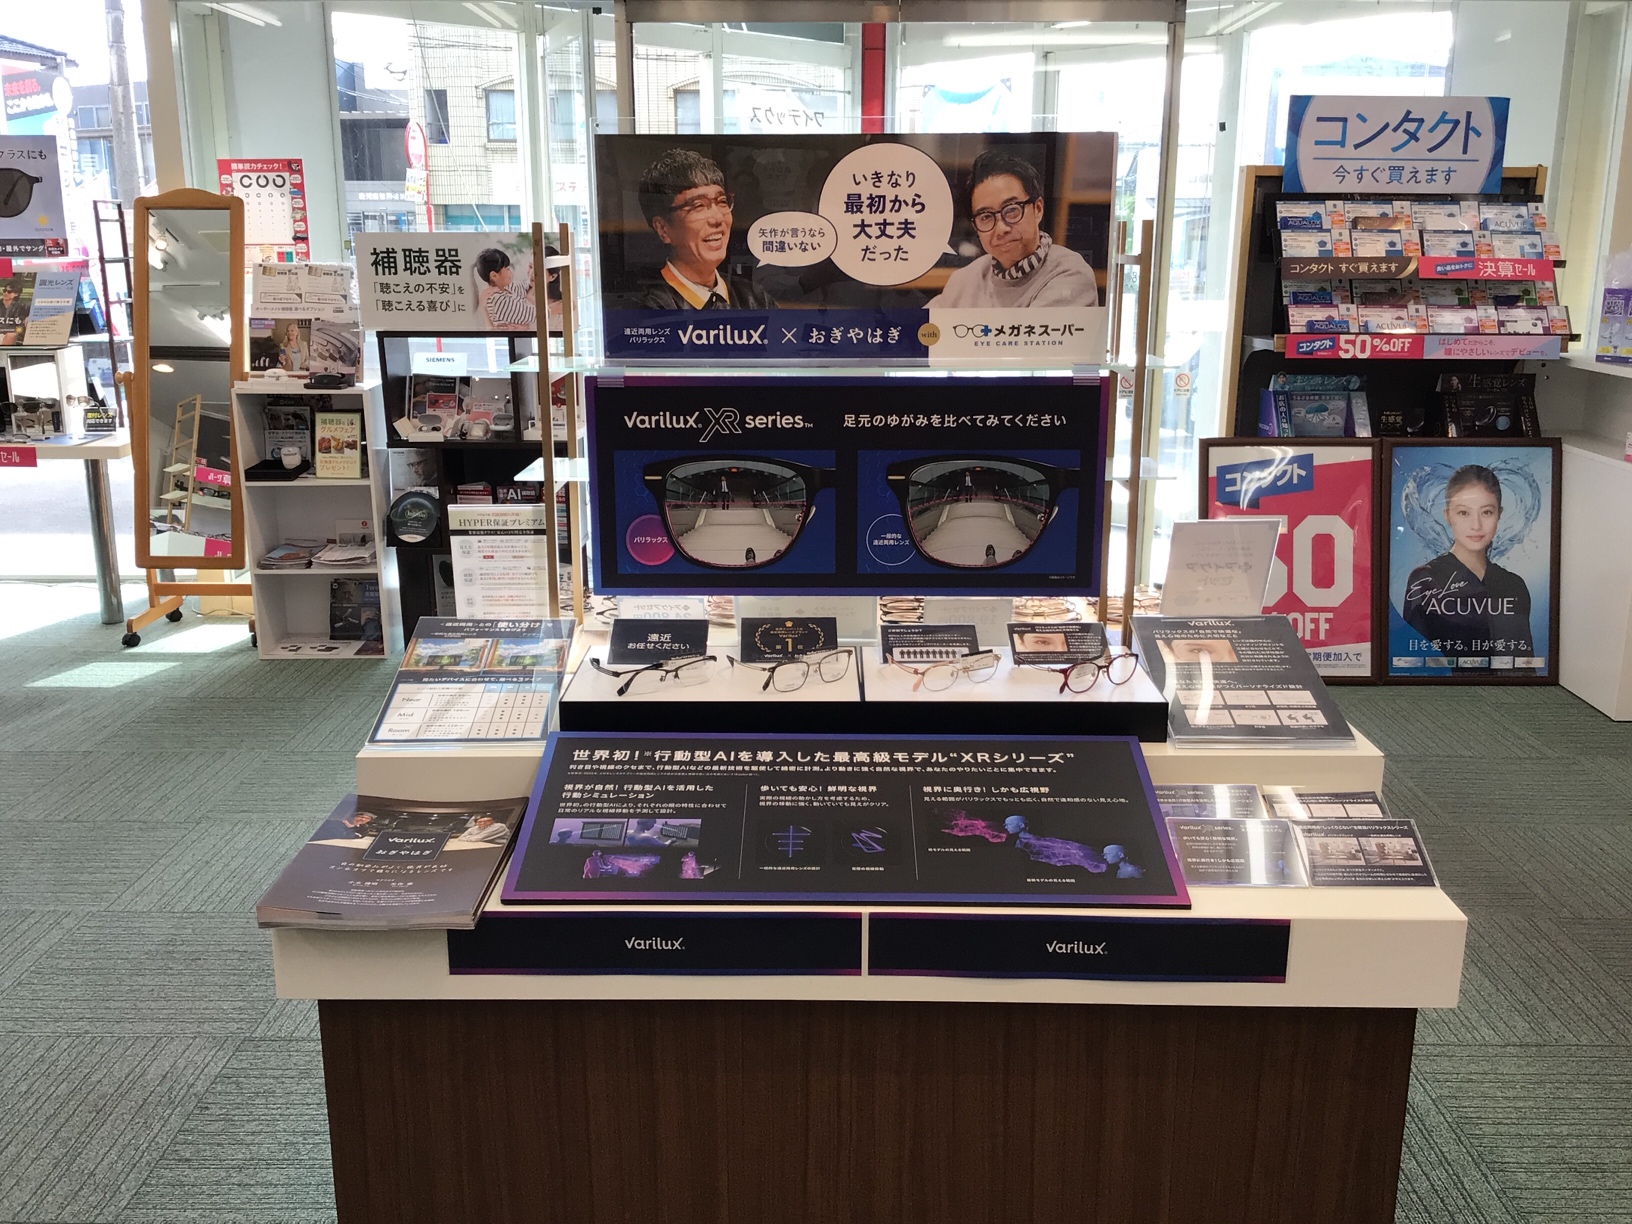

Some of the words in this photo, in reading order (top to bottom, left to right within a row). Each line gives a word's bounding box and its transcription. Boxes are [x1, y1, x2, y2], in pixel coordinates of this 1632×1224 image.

[1312, 108, 1482, 155] コンタクト
[851, 170, 918, 188] いきなり
[1332, 164, 1457, 186] 今すぐ買えます
[843, 193, 926, 214] 最初から
[757, 227, 826, 240] 矢作が言うなら
[851, 219, 918, 240] 大丈夫
[761, 239, 822, 254] 間違いない
[860, 245, 910, 262] だった
[370, 247, 463, 277] 補聴器
[1290, 263, 1334, 274] コンタクト
[1339, 262, 1399, 273] すぐ買えます
[1478, 260, 1536, 278] 決算セール
[373, 282, 466, 295] 「聴こえの不安」を
[375, 300, 466, 313] 「聴こえる喜び」に
[623, 327, 671, 336] 遠近両用レンズ
[808, 326, 902, 345] おぎやはぎ
[921, 331, 938, 340] with
[993, 323, 1085, 338] メガネスーパー
[629, 336, 666, 345] バリラックス
[1298, 340, 1333, 352] コンタクト
[623, 410, 699, 429] Varilux
[698, 407, 743, 443] XR
[843, 413, 1067, 428] 足元のゆがみを比べてみてください
[459, 518, 545, 527] HYPER保証プレミアム
[633, 536, 669, 544] バリラックス
[1406, 577, 1442, 606] Eye
[1438, 570, 1469, 599] Love
[1425, 597, 1515, 615] ACUVUE
[646, 633, 672, 642] 遠近
[1408, 639, 1468, 651] 目を愛する。
[1471, 639, 1532, 651] 目が愛する。
[627, 642, 690, 650] お任せください
[625, 936, 683, 950] Varilux
[1046, 940, 1106, 955] Varilux
